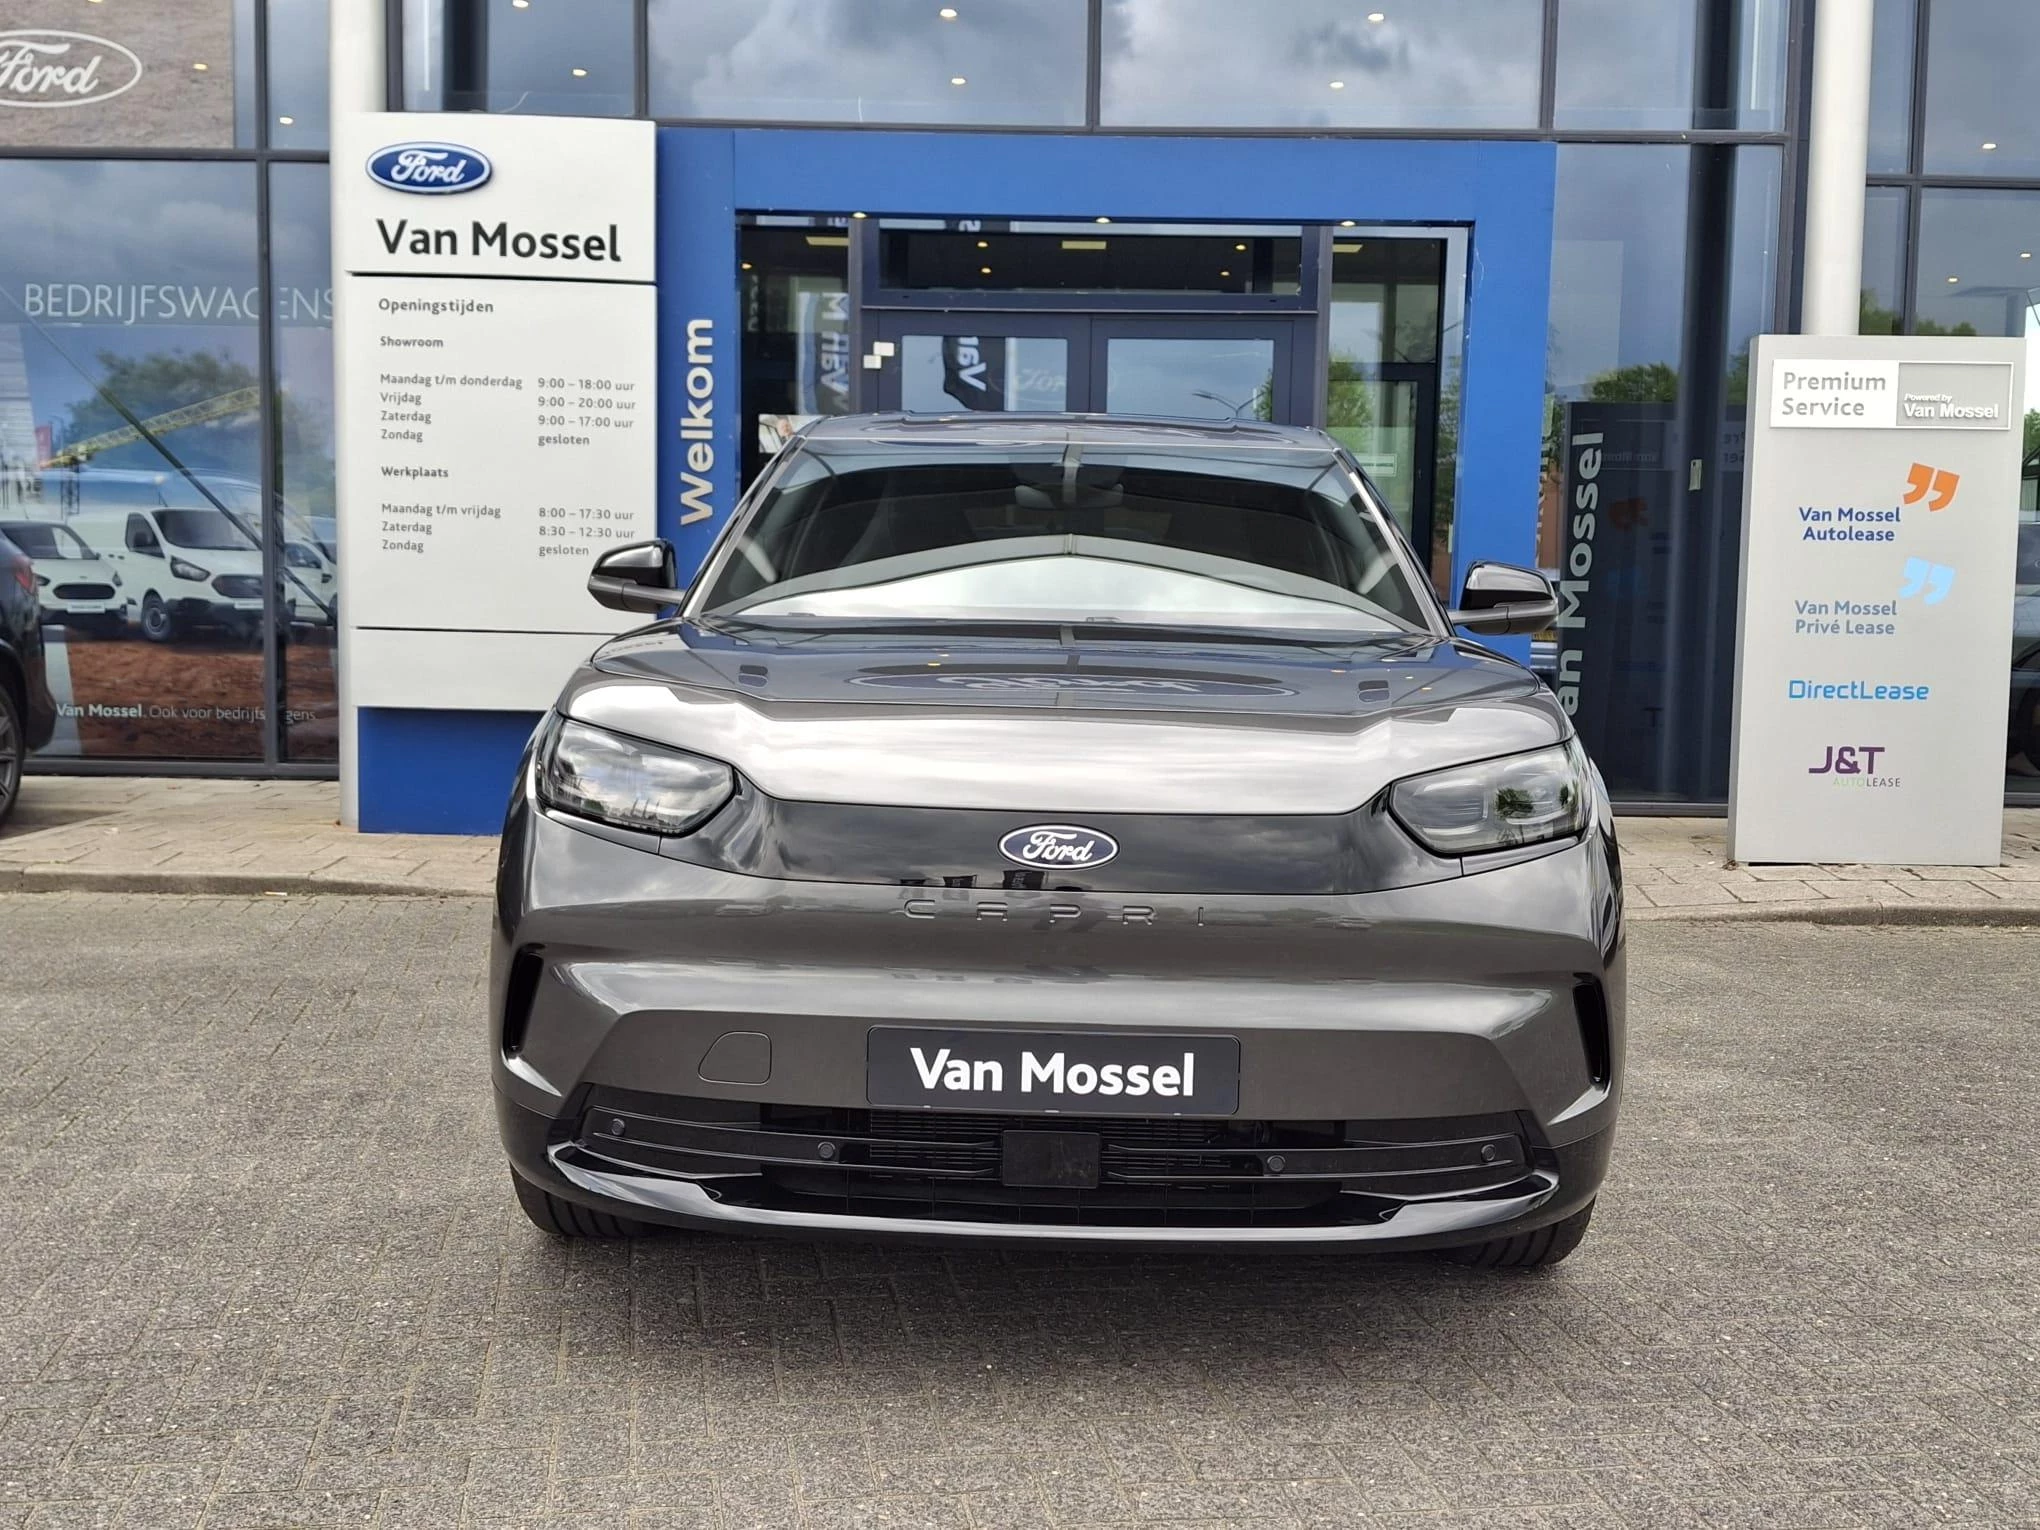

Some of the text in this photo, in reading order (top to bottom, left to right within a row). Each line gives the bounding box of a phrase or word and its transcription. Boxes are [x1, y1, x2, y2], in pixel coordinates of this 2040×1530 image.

[391, 149, 466, 184] Ford
[376, 218, 622, 263] Van Mossel
[378, 297, 494, 316] Openingstijden
[380, 335, 444, 349] Showroom
[380, 373, 432, 388] Maandag
[435, 374, 457, 386] t/m
[460, 375, 523, 391] donderdag
[537, 377, 565, 389] 9:00
[578, 378, 612, 391] 18:00
[615, 381, 636, 392] uur
[1783, 371, 1886, 391] Premium
[380, 391, 422, 407] Vrijdag
[537, 396, 565, 408] 9:00
[578, 397, 613, 410] 20:00
[616, 400, 636, 411] uur
[1782, 397, 1865, 416] Service
[380, 410, 432, 425] Zaterdag
[537, 414, 565, 427] 9:00
[578, 415, 612, 428] 17:00
[613, 418, 634, 429] uur
[1903, 403, 1999, 420] Van Mossel
[680, 319, 714, 525] Welkom
[380, 429, 590, 447] Zondag gesloten
[381, 466, 449, 480] Werkplaats
[381, 503, 433, 518] Maandag
[436, 504, 458, 516] t/m
[461, 505, 502, 519] vrijdag
[539, 507, 566, 519] 8:00
[579, 508, 612, 520] 17:30
[614, 511, 635, 521] uur
[1798, 506, 1901, 522] Van Mossel
[381, 521, 433, 535] Zaterdag
[539, 526, 566, 538] 8:30
[579, 527, 612, 539] 12:30
[615, 529, 636, 540] uur
[1803, 526, 1895, 541] Autolease
[381, 540, 590, 558] Zondag gesloten
[1557, 432, 1604, 716] an Mossel
[1795, 600, 1897, 616] Van Mossel
[1795, 619, 1895, 635] Privé Lease
[1788, 680, 1930, 700] DirectLease
[55, 703, 84, 717] Van
[150, 704, 176, 718] Ook
[183, 706, 214, 719] voor
[1808, 745, 1886, 775] J&T
[1023, 830, 1096, 862] Ford
[904, 898, 1205, 926] CAPRI
[909, 1047, 1195, 1097] Van Mossel
